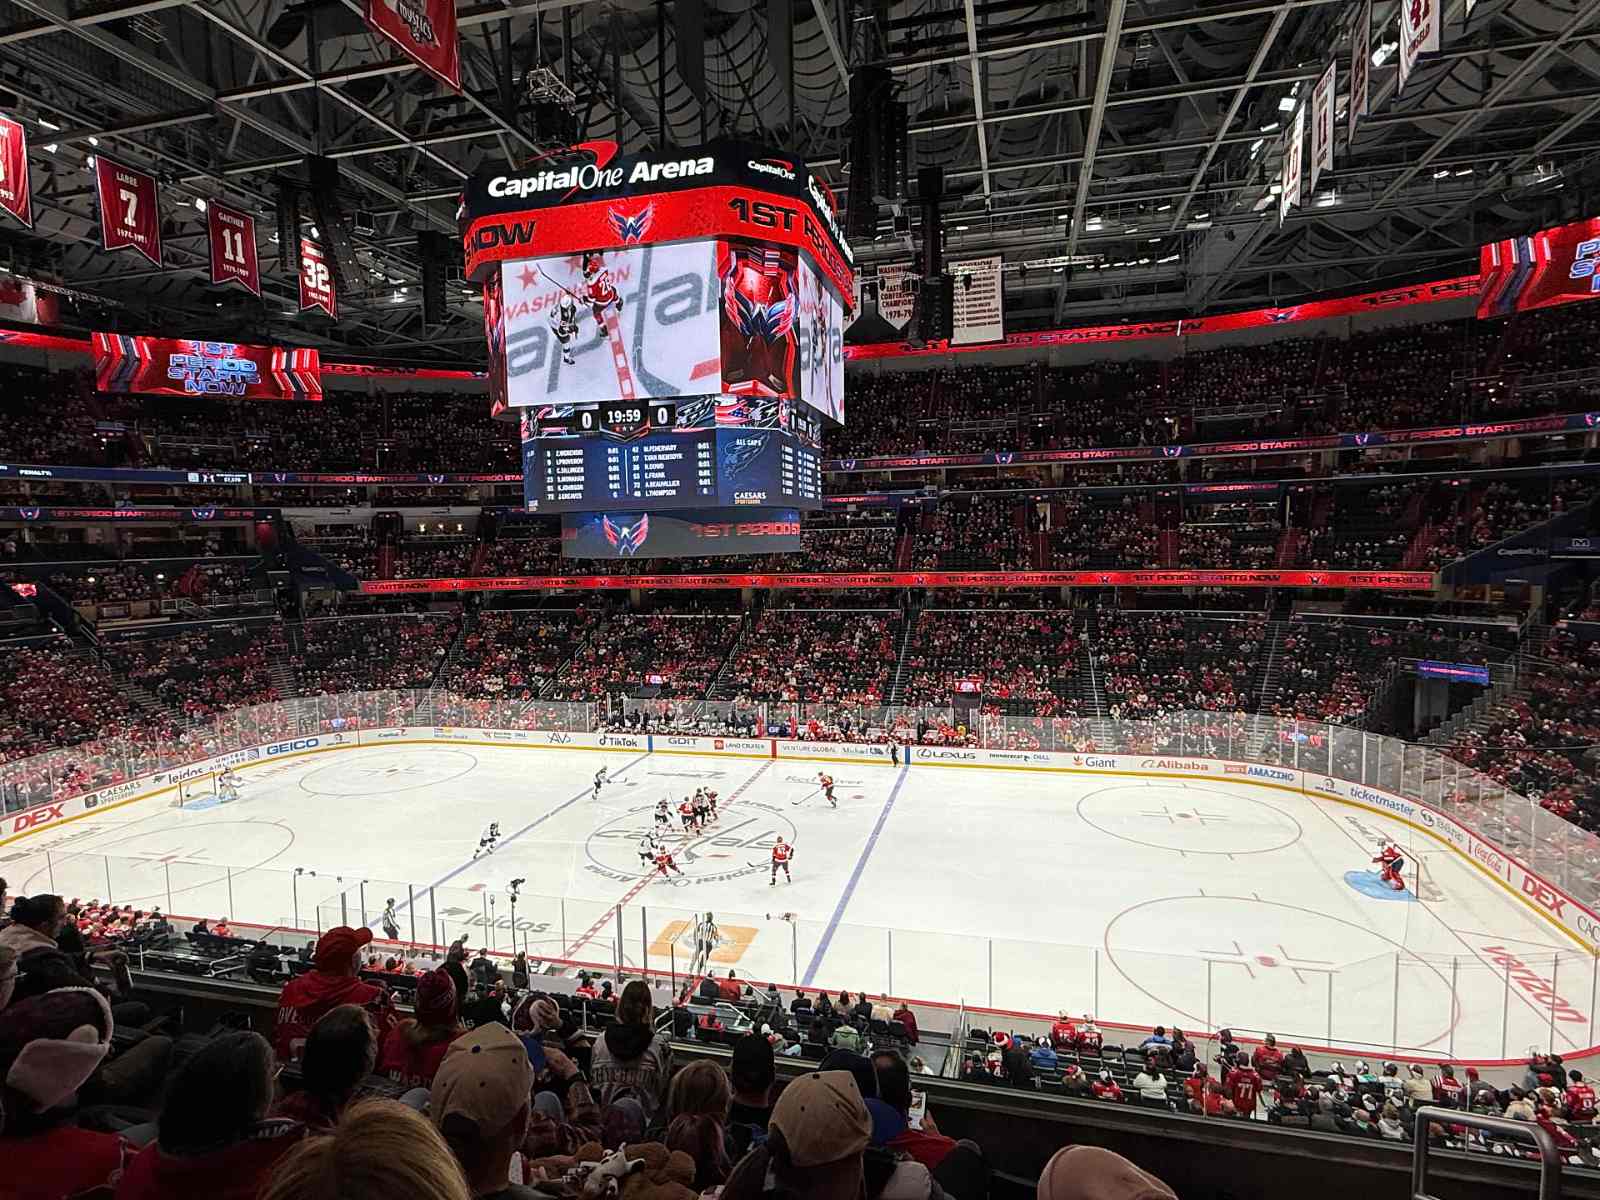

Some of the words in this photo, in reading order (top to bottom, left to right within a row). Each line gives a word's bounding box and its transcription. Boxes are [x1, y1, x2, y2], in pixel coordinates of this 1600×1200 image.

[628, 156, 715, 186] Arena
[119, 188, 138, 228] 7
[727, 196, 798, 233] 1ST
[474, 219, 537, 251] NOW
[222, 228, 246, 265] 11
[303, 257, 331, 294] 32
[169, 354, 259, 373] PERIOD
[167, 366, 262, 385] STARTS
[184, 378, 247, 396] NOW
[582, 412, 594, 429] 0
[607, 408, 641, 424] 19:59
[657, 407, 669, 424] 0
[1410, 428, 1462, 443] PERIOD
[1042, 451, 1080, 461] PERIOD
[734, 491, 768, 500] CAESARS
[266, 737, 320, 756] GEICO
[609, 737, 639, 750] TikTok
[667, 736, 697, 746] GDIT
[923, 751, 977, 761] LEXUS
[1085, 755, 1117, 769] Giant
[1157, 759, 1209, 772] Alibaba
[1247, 765, 1297, 782] AMAZING
[99, 781, 142, 799] CAESARS
[1350, 786, 1415, 816] ticketmaster
[14, 803, 65, 833] DEX
[1521, 873, 1568, 920] DEX
[463, 910, 552, 936] leidos
[1480, 945, 1589, 1023] verizon
[1238, 1083, 1253, 1100] 77
